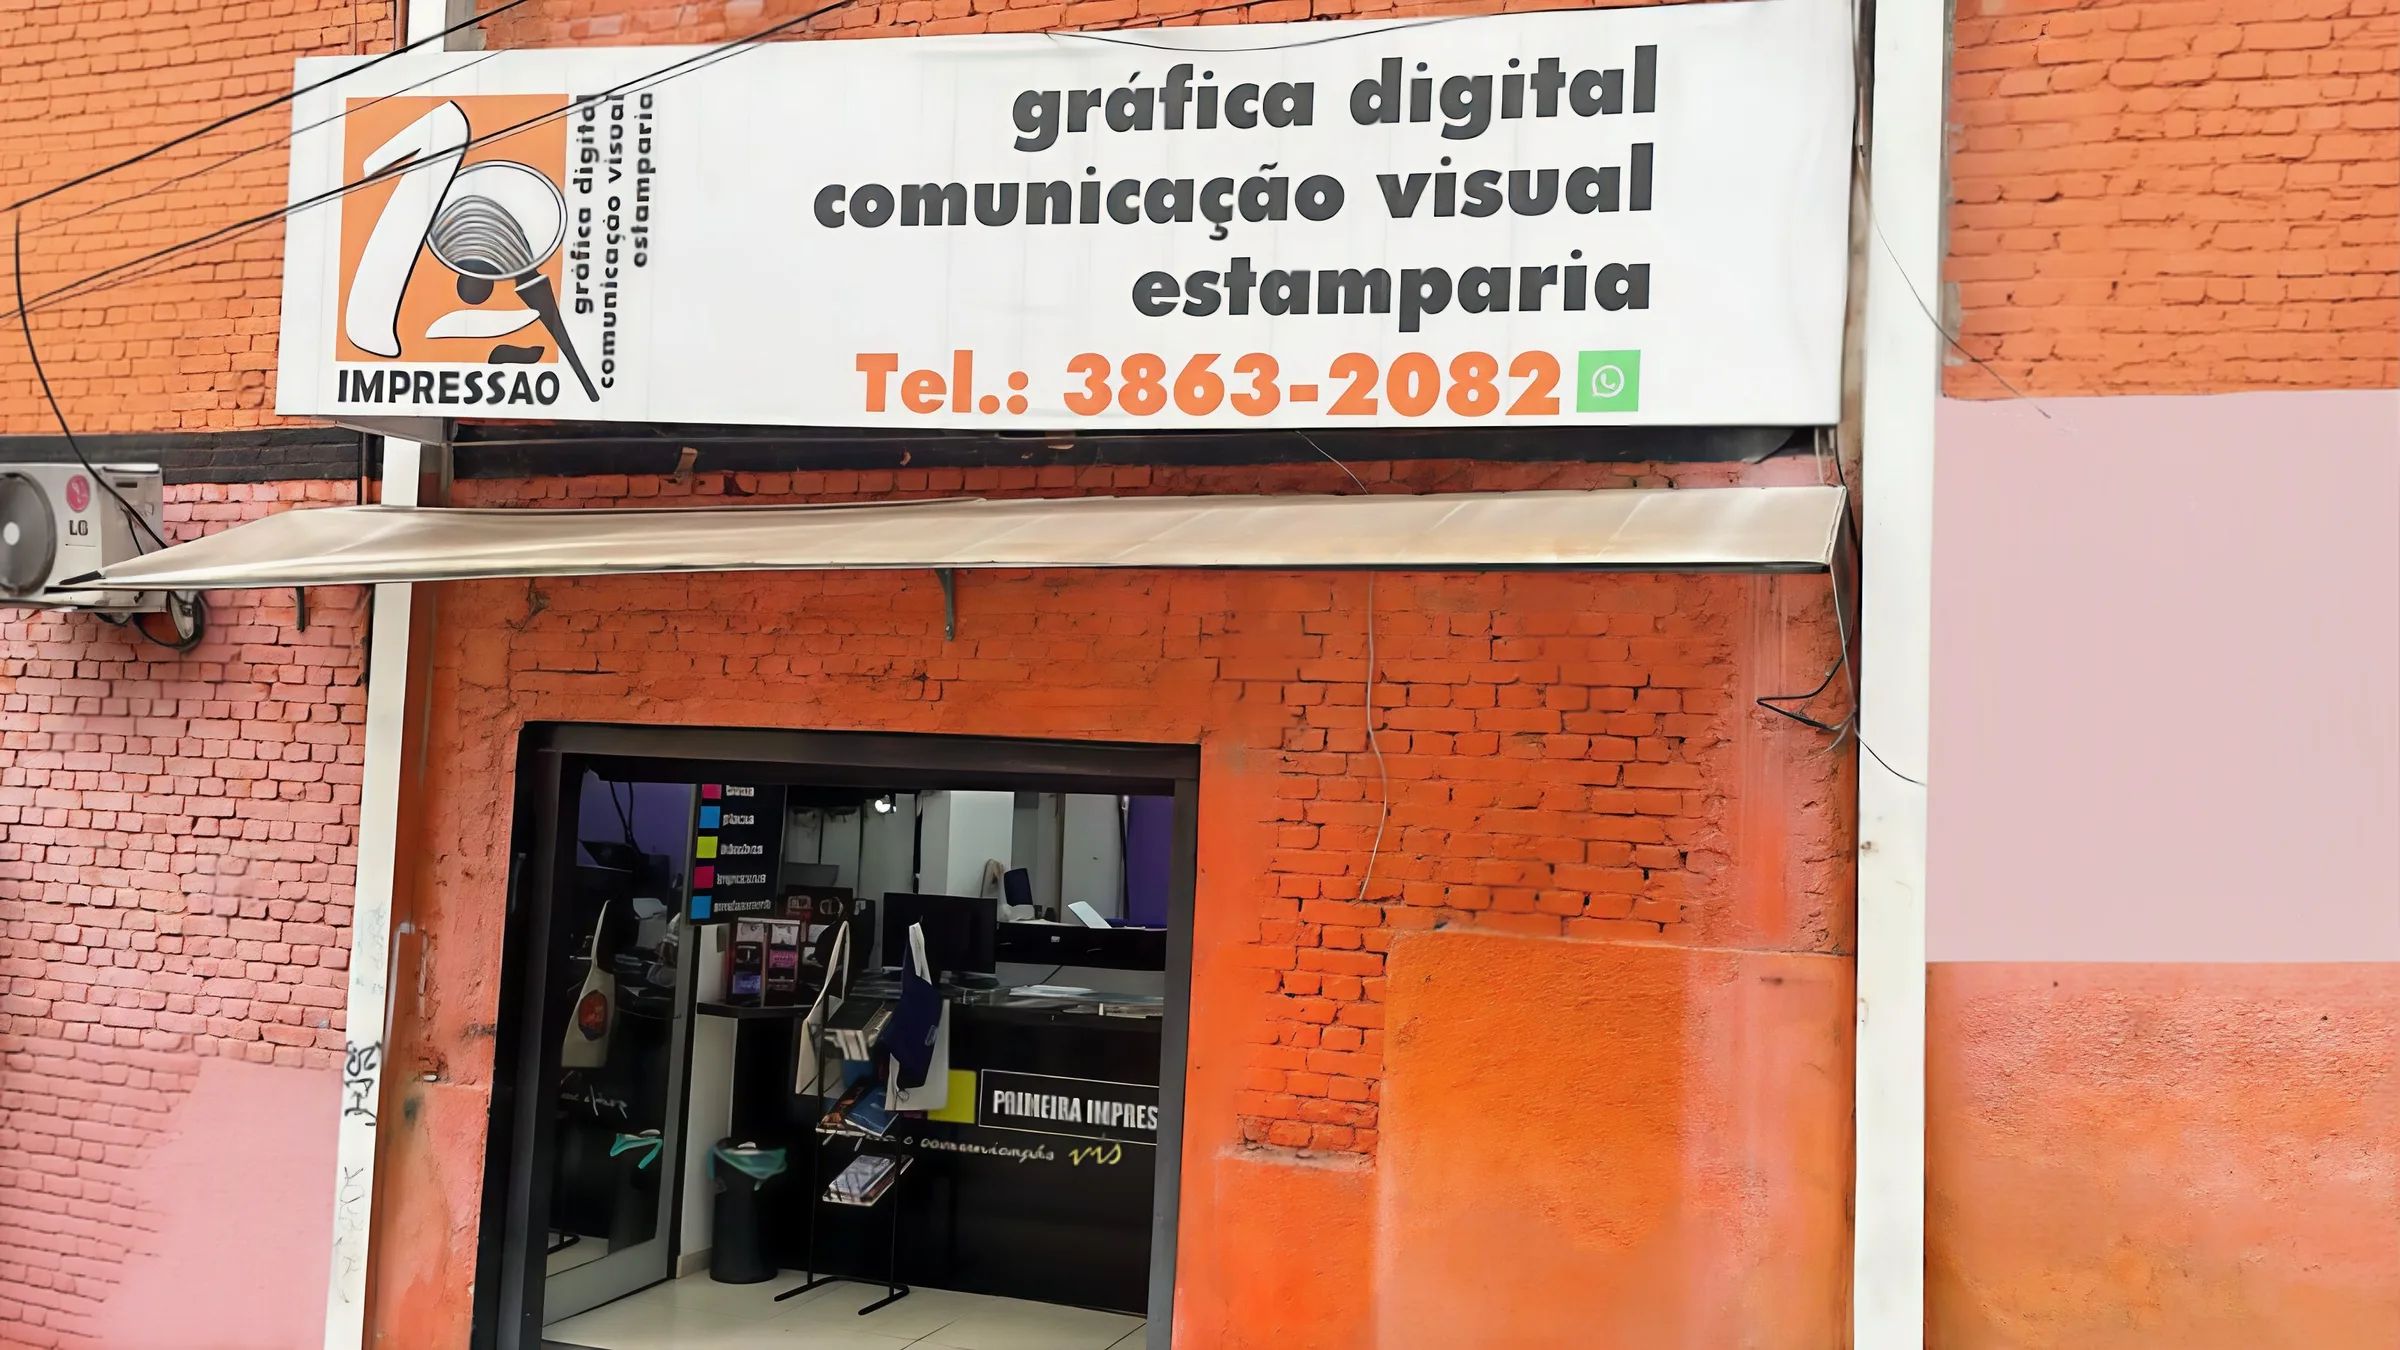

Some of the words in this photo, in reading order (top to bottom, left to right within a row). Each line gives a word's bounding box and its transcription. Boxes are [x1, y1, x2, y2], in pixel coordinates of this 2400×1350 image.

[1013, 64, 1315, 153] gráfica
[1350, 45, 1658, 141] digital
[814, 162, 1345, 242] comunicação
[1376, 143, 1654, 219] visual
[1132, 249, 1651, 333] estamparia
[856, 350, 1028, 415] Tel.:
[1064, 351, 1561, 417] 3863-2082
